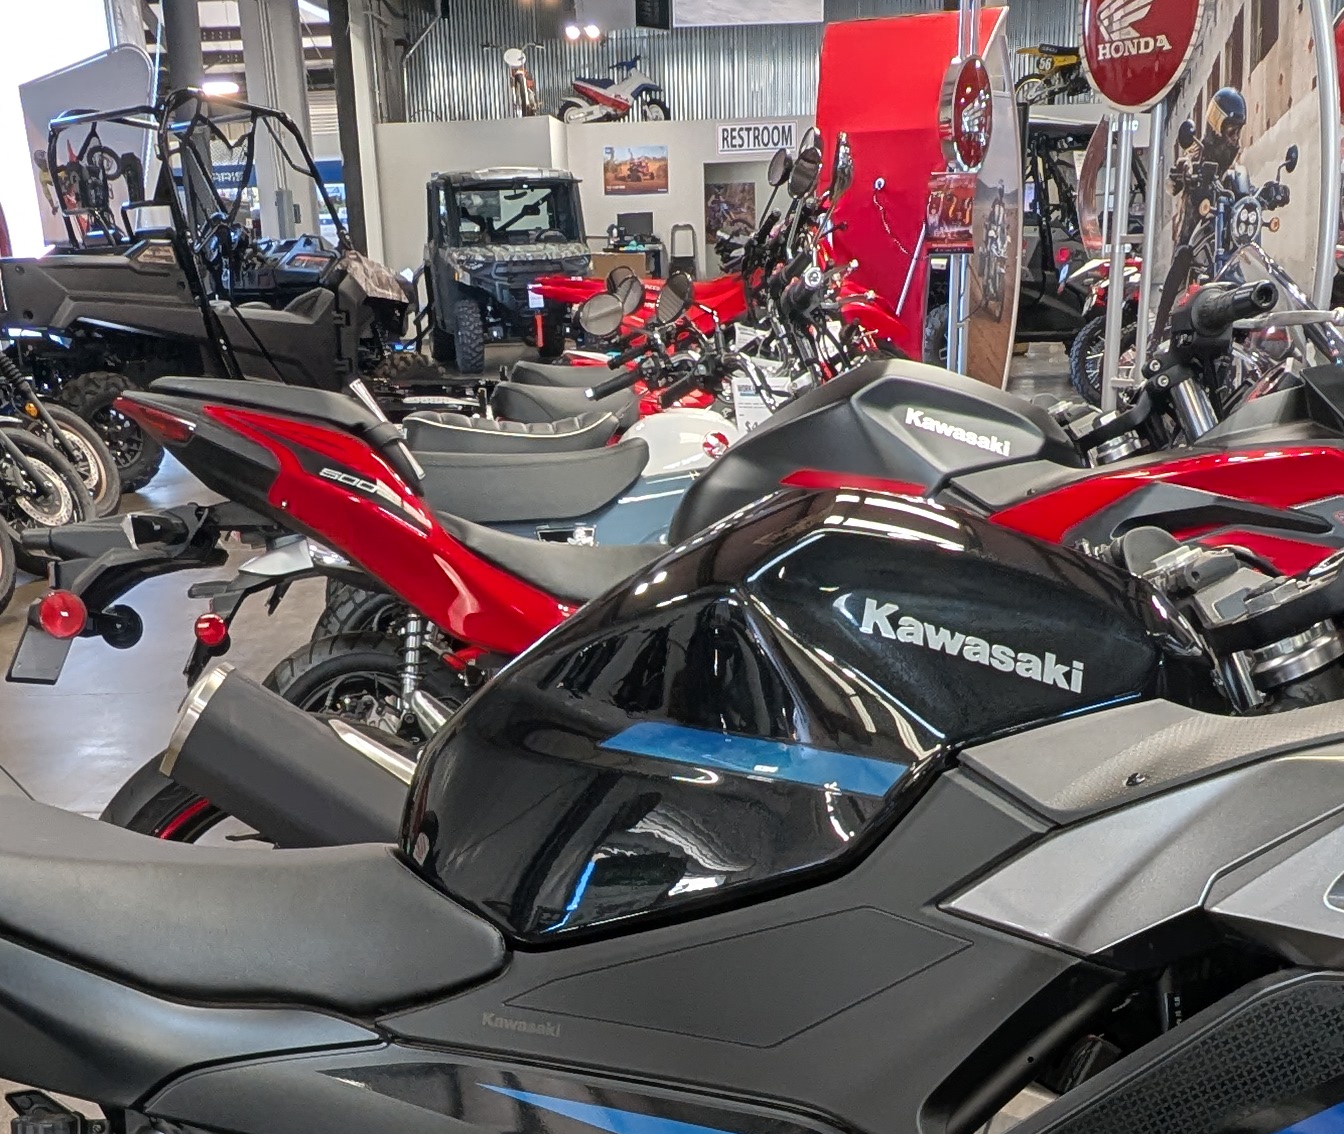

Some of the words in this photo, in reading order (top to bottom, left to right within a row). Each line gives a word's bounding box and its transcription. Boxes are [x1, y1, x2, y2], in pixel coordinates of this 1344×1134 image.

[1097, 35, 1172, 60] HONDA
[721, 125, 793, 149] RESTROOM
[905, 407, 1010, 457] Kawasaki
[319, 467, 379, 494] 500
[859, 598, 1084, 694] Kawasaki
[481, 1011, 561, 1038] Kawasaki
